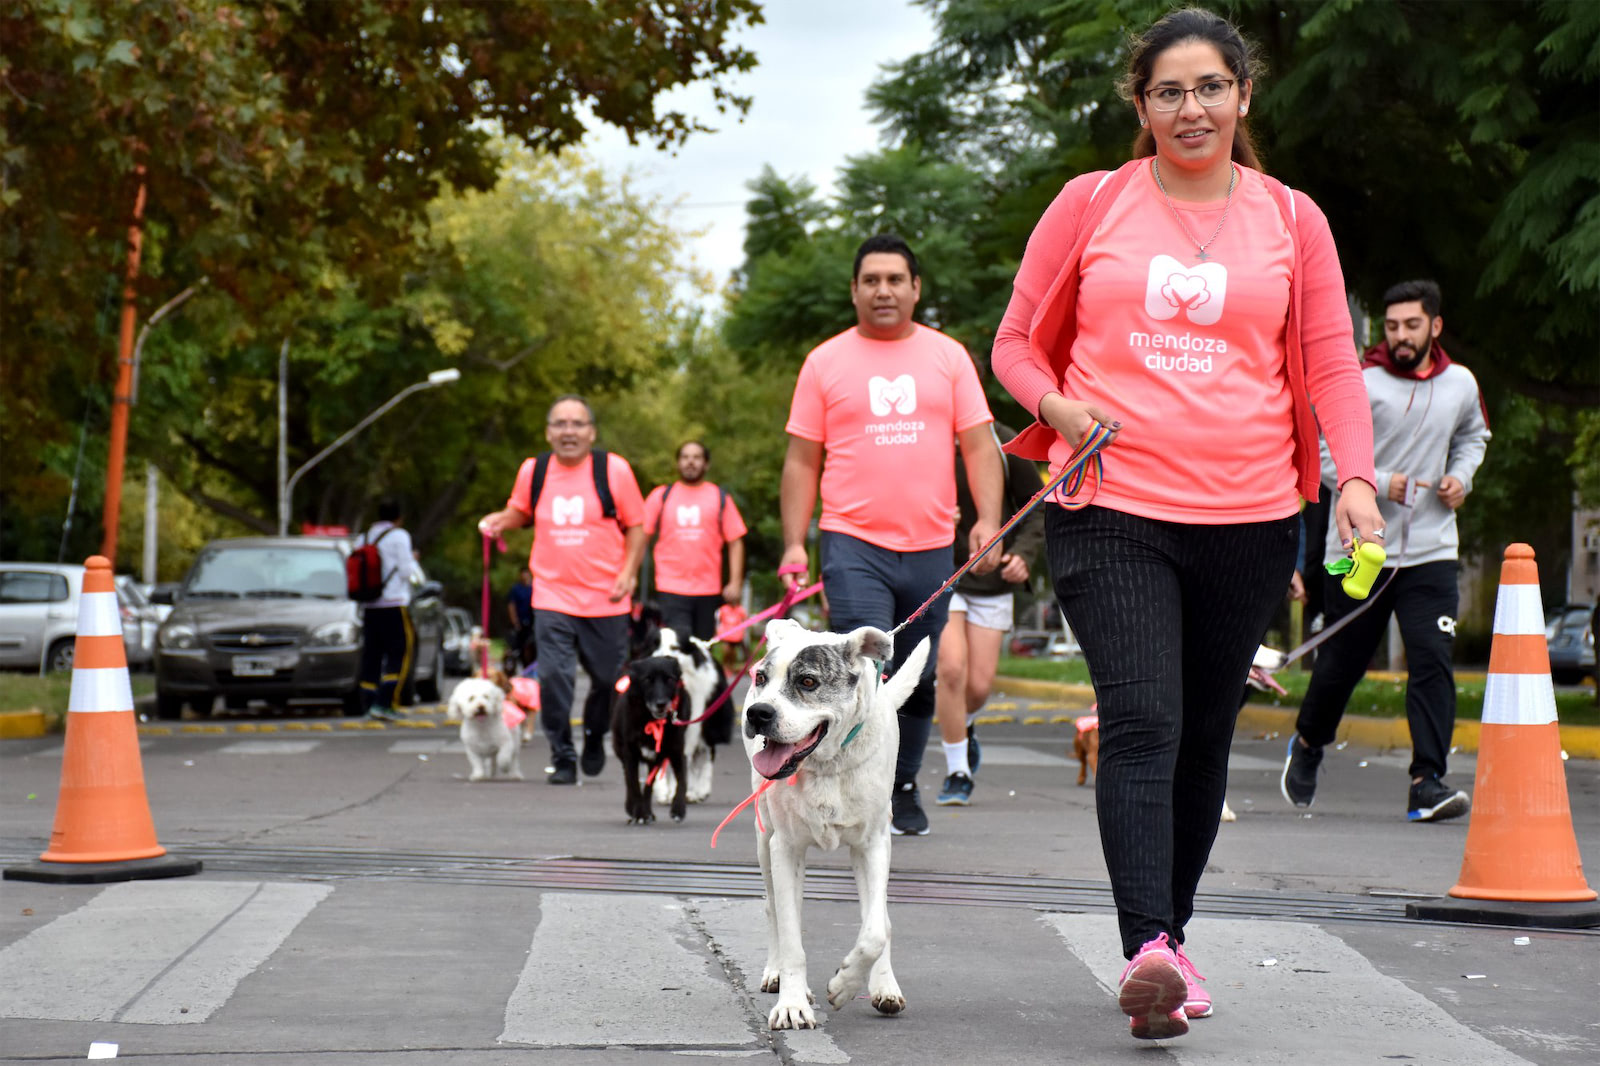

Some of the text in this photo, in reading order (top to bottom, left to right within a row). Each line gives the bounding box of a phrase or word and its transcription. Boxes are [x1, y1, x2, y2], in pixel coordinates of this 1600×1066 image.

[1129, 332, 1227, 353] mendoza
[1145, 352, 1213, 373] ciudad
[865, 420, 925, 434] mendoza
[875, 432, 917, 446] ciudad
